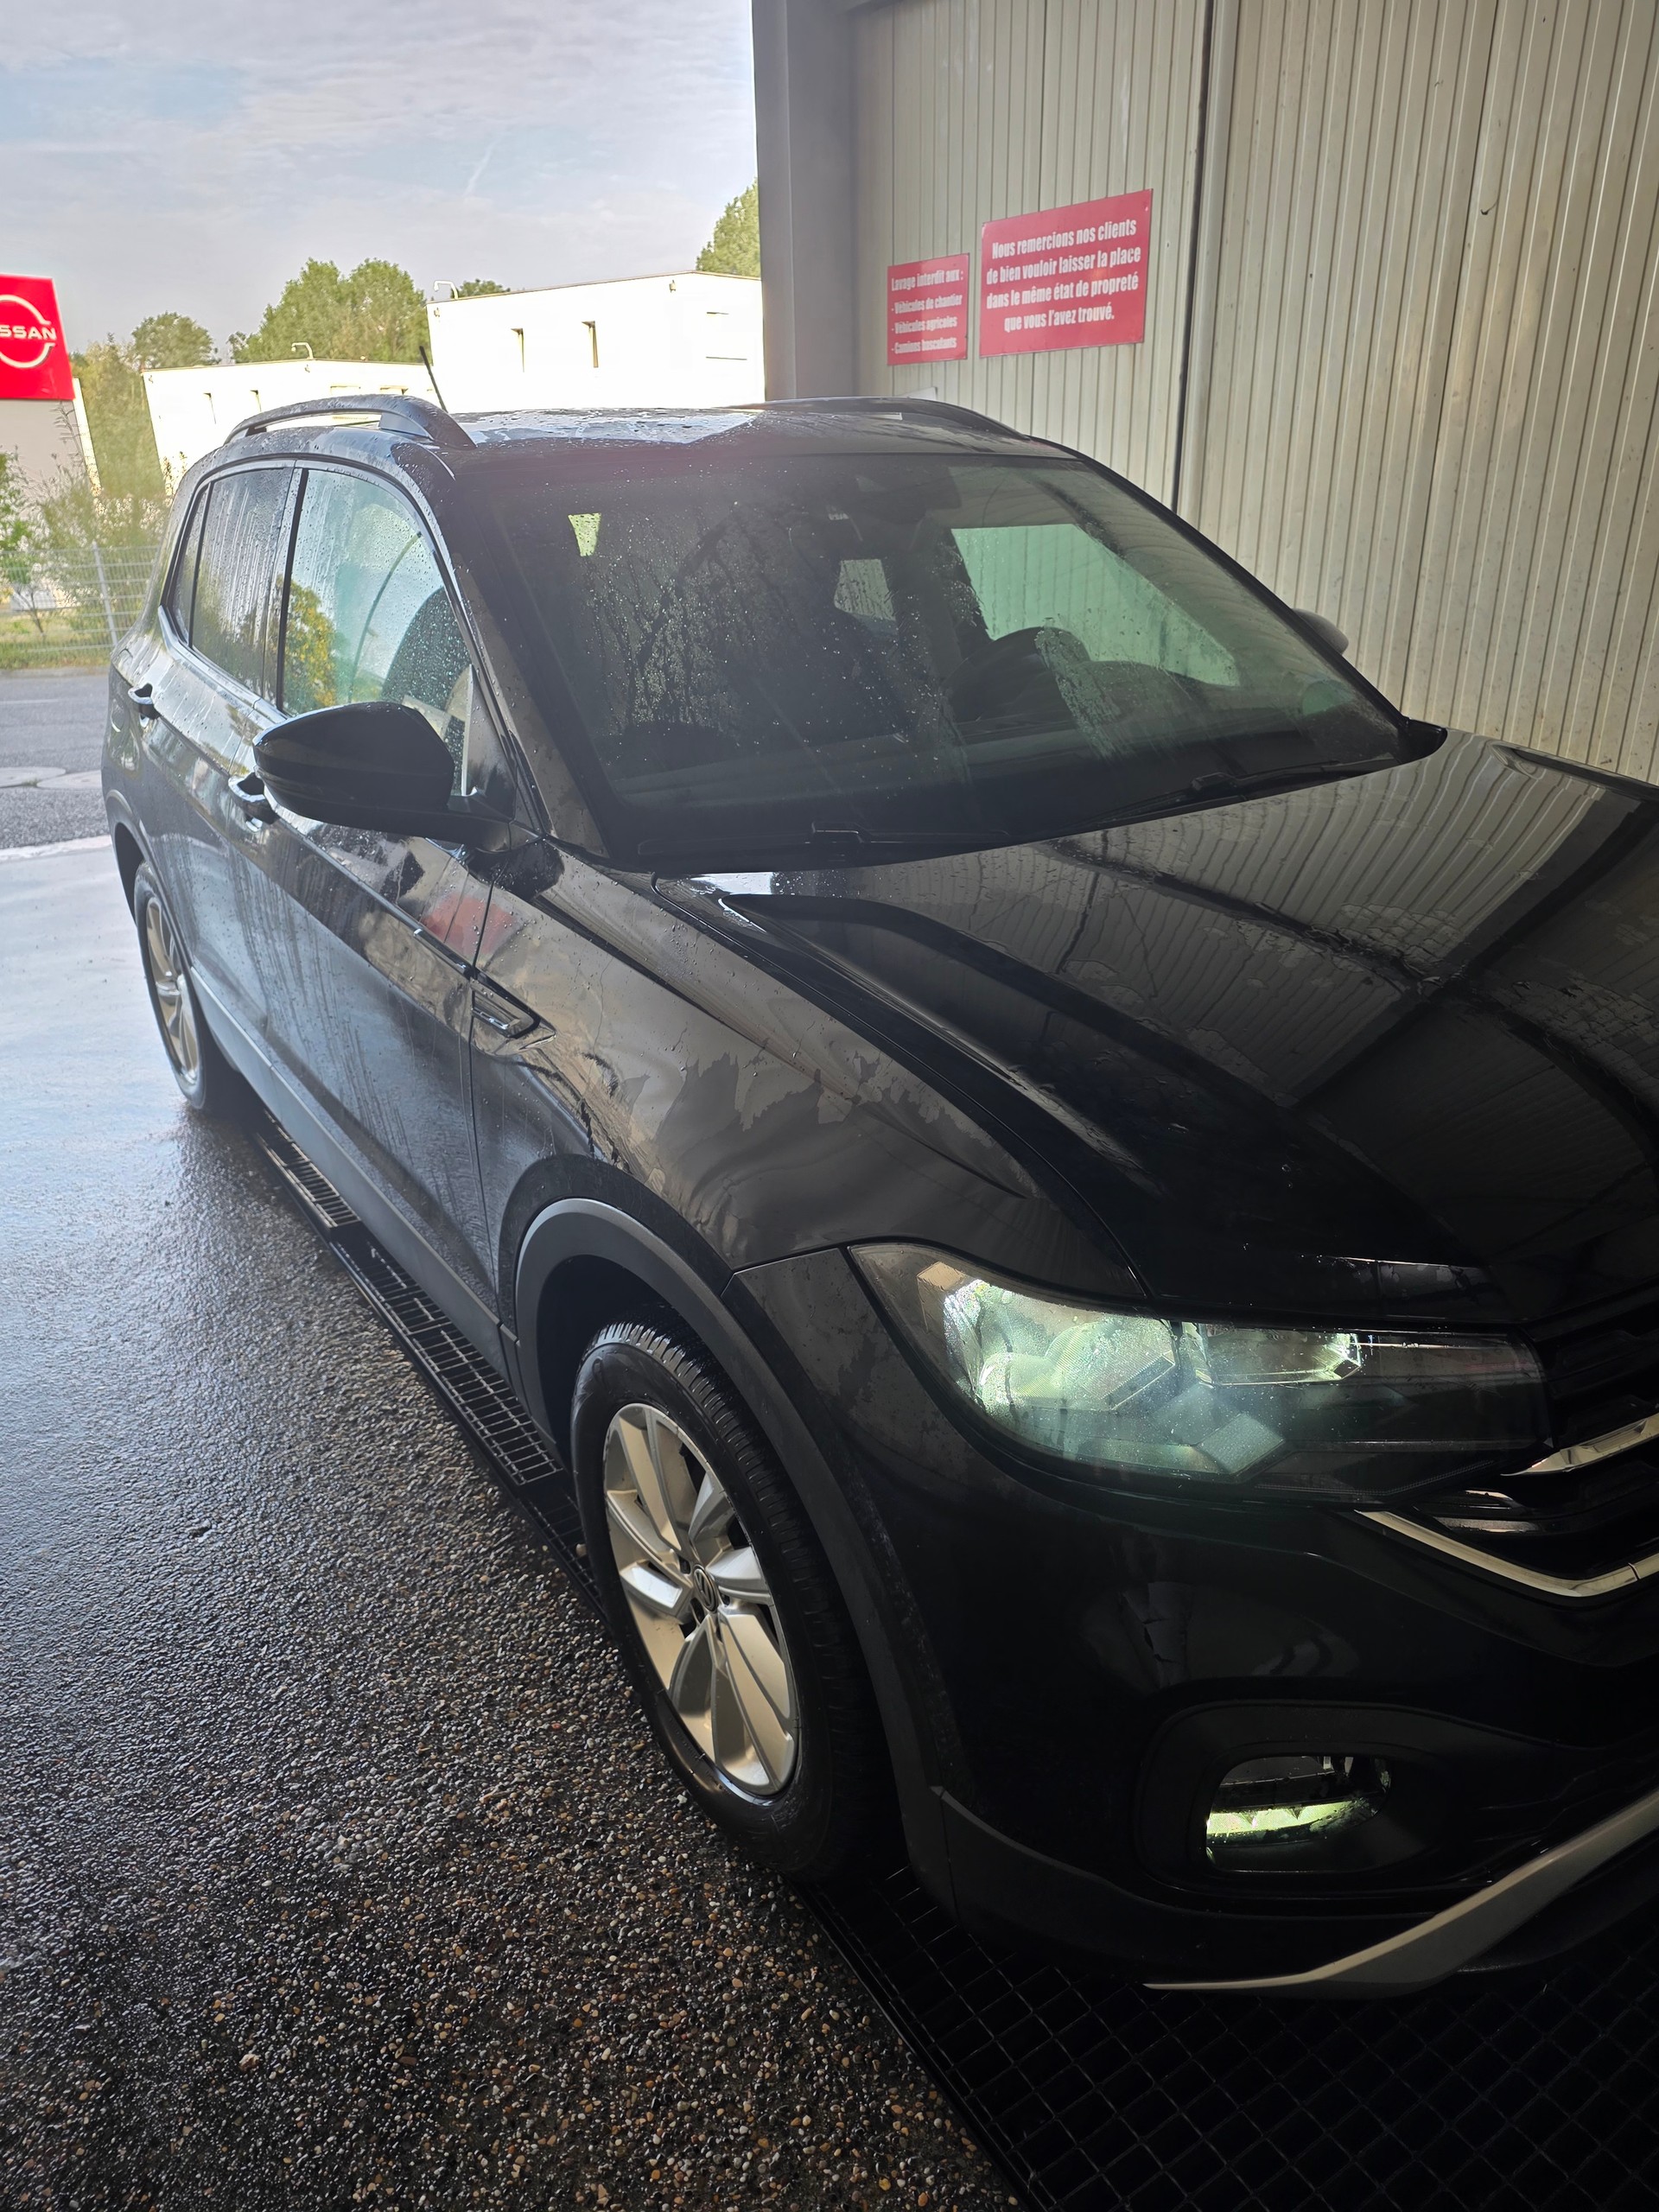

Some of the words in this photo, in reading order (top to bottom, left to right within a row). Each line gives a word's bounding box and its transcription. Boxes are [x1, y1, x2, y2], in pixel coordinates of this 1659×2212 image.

[992, 242, 1015, 259] Nous
[1017, 231, 1074, 255] remercions
[1076, 227, 1096, 245] nos
[1097, 219, 1136, 241] clients
[891, 276, 916, 291] Lavage
[917, 270, 944, 287] interdit
[986, 268, 998, 285] de
[1000, 265, 1020, 283] bien
[1022, 258, 1058, 279] vouloir
[1058, 254, 1096, 274] laisser
[1097, 250, 1108, 268] la
[1109, 246, 1141, 268] place
[986, 292, 1009, 309] dans
[1010, 289, 1020, 306] le
[1021, 285, 1052, 304] même
[1053, 283, 1074, 300] état
[1076, 280, 1089, 297] de
[1090, 271, 1139, 297] propreté
[1004, 316, 1021, 333] que
[1024, 313, 1046, 329] vous
[1048, 308, 1077, 327] l'avez
[1077, 302, 1115, 322] trouvé.
